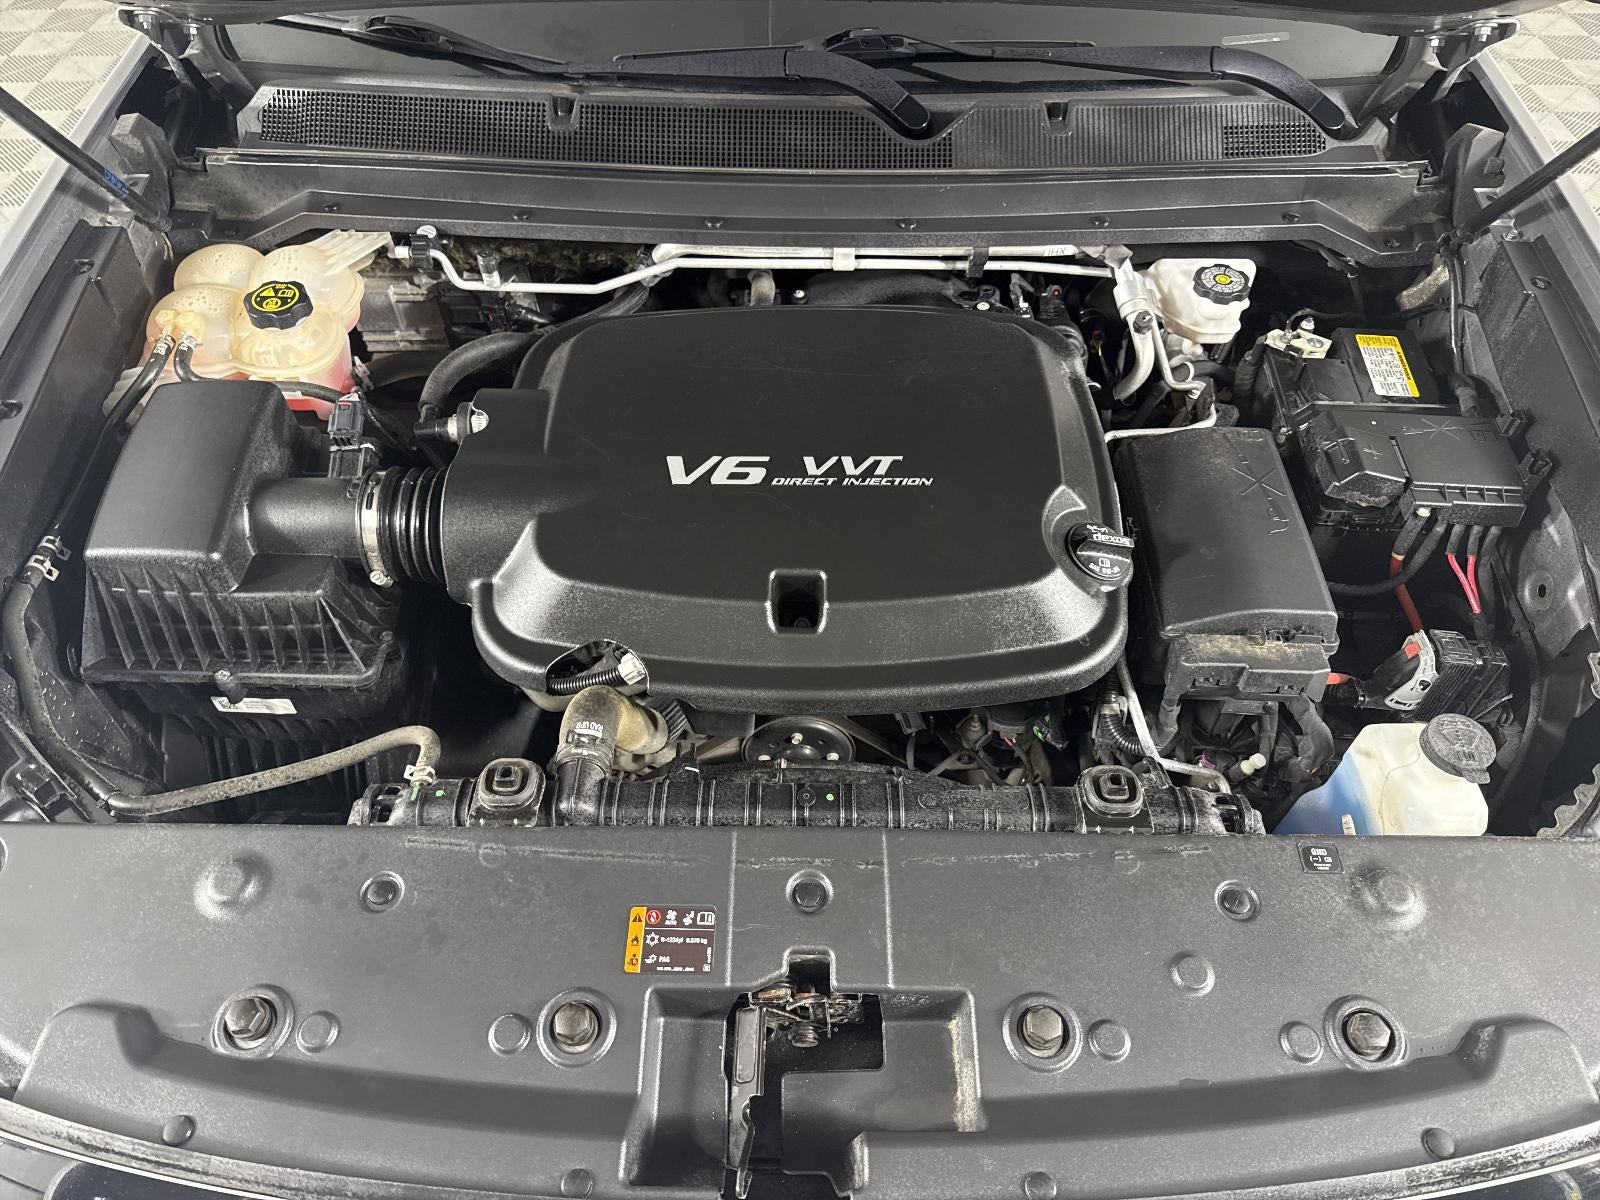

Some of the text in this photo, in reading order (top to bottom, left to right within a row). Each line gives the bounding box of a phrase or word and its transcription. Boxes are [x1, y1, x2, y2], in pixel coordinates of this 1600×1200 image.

[666, 455, 904, 485] V6 VVT
[771, 477, 934, 487] DIRECT INJECTION
[1093, 533, 1130, 546] dexos
[575, 721, 604, 731] RAD UPR
